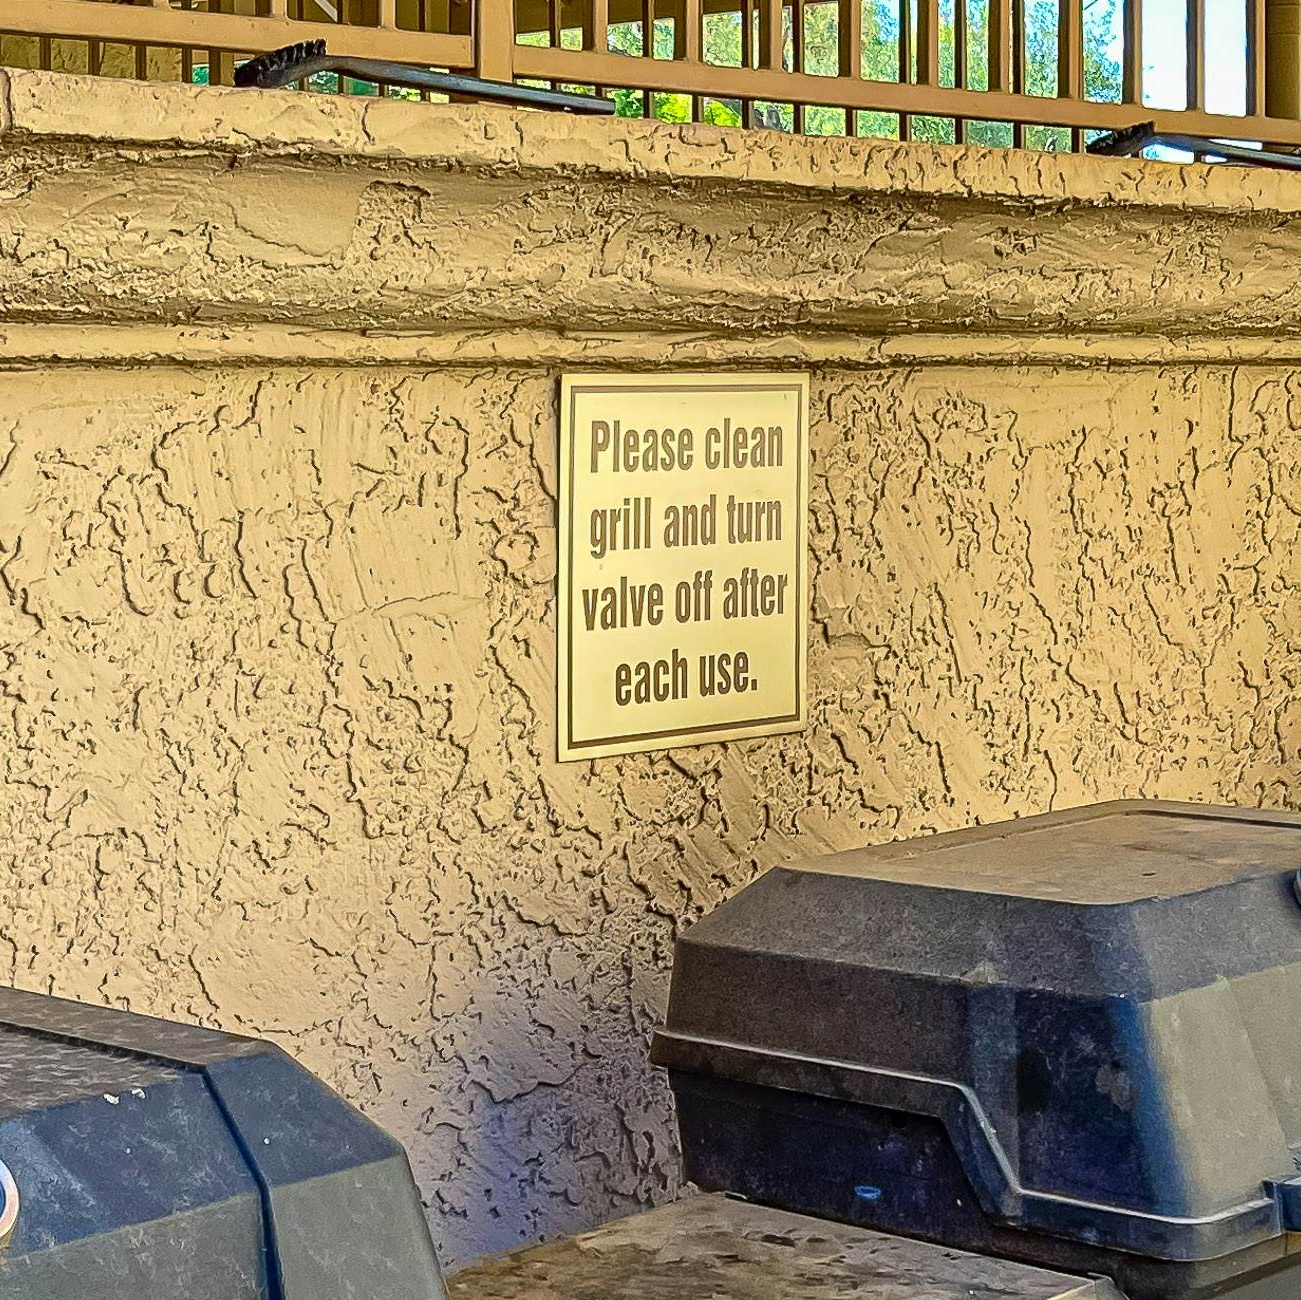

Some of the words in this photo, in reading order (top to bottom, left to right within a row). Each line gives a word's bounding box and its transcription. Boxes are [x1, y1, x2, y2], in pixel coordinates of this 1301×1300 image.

[590, 420, 694, 473] Please
[705, 418, 783, 470] clean
[589, 497, 651, 559] grill
[664, 494, 716, 548] and
[727, 495, 782, 544] turn
[582, 576, 664, 631] valve
[675, 570, 713, 623] off
[723, 567, 788, 623] after
[616, 649, 688, 706] each
[700, 650, 758, 697] use.
